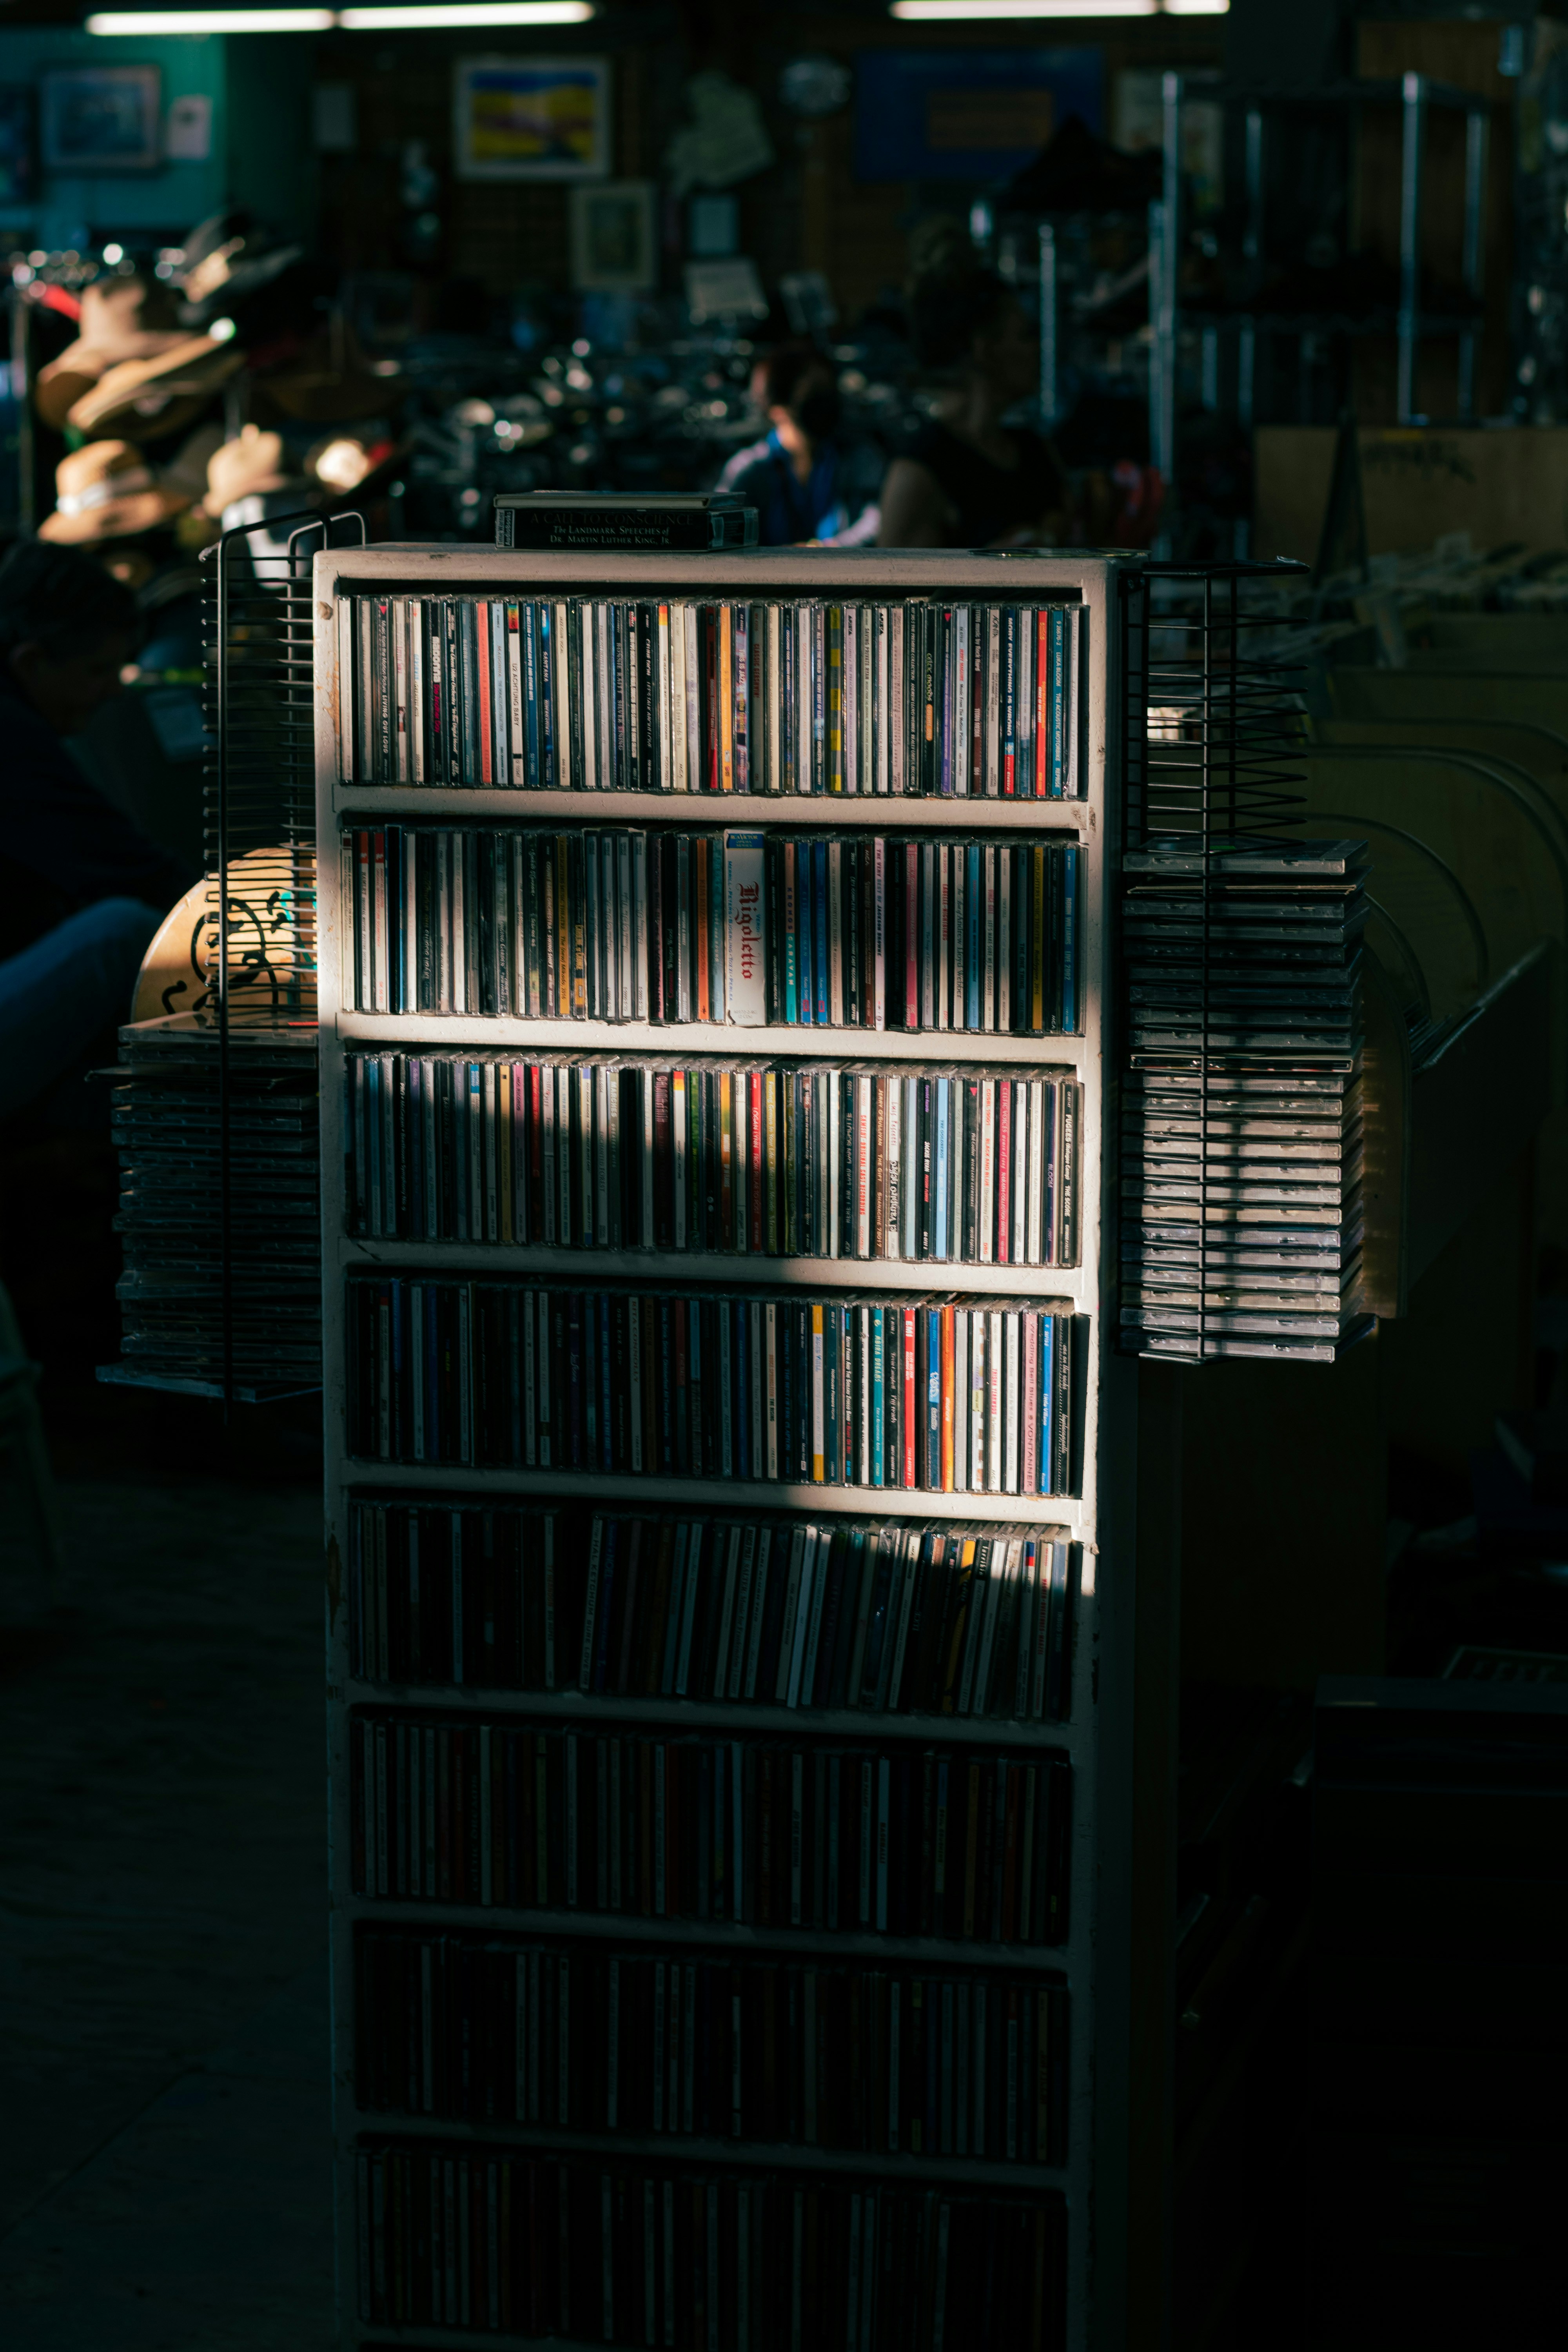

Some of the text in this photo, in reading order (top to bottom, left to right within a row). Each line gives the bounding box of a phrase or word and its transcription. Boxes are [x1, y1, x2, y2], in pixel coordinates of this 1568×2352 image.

[531, 513, 694, 525] A CALL TO CONSCIENCE
[568, 526, 615, 534] LANDMARK
[619, 526, 661, 535] SPEECHES
[512, 663, 517, 672] U2
[734, 881, 763, 979] Rigoletto
[588, 1564, 597, 1615] KETCHUM
